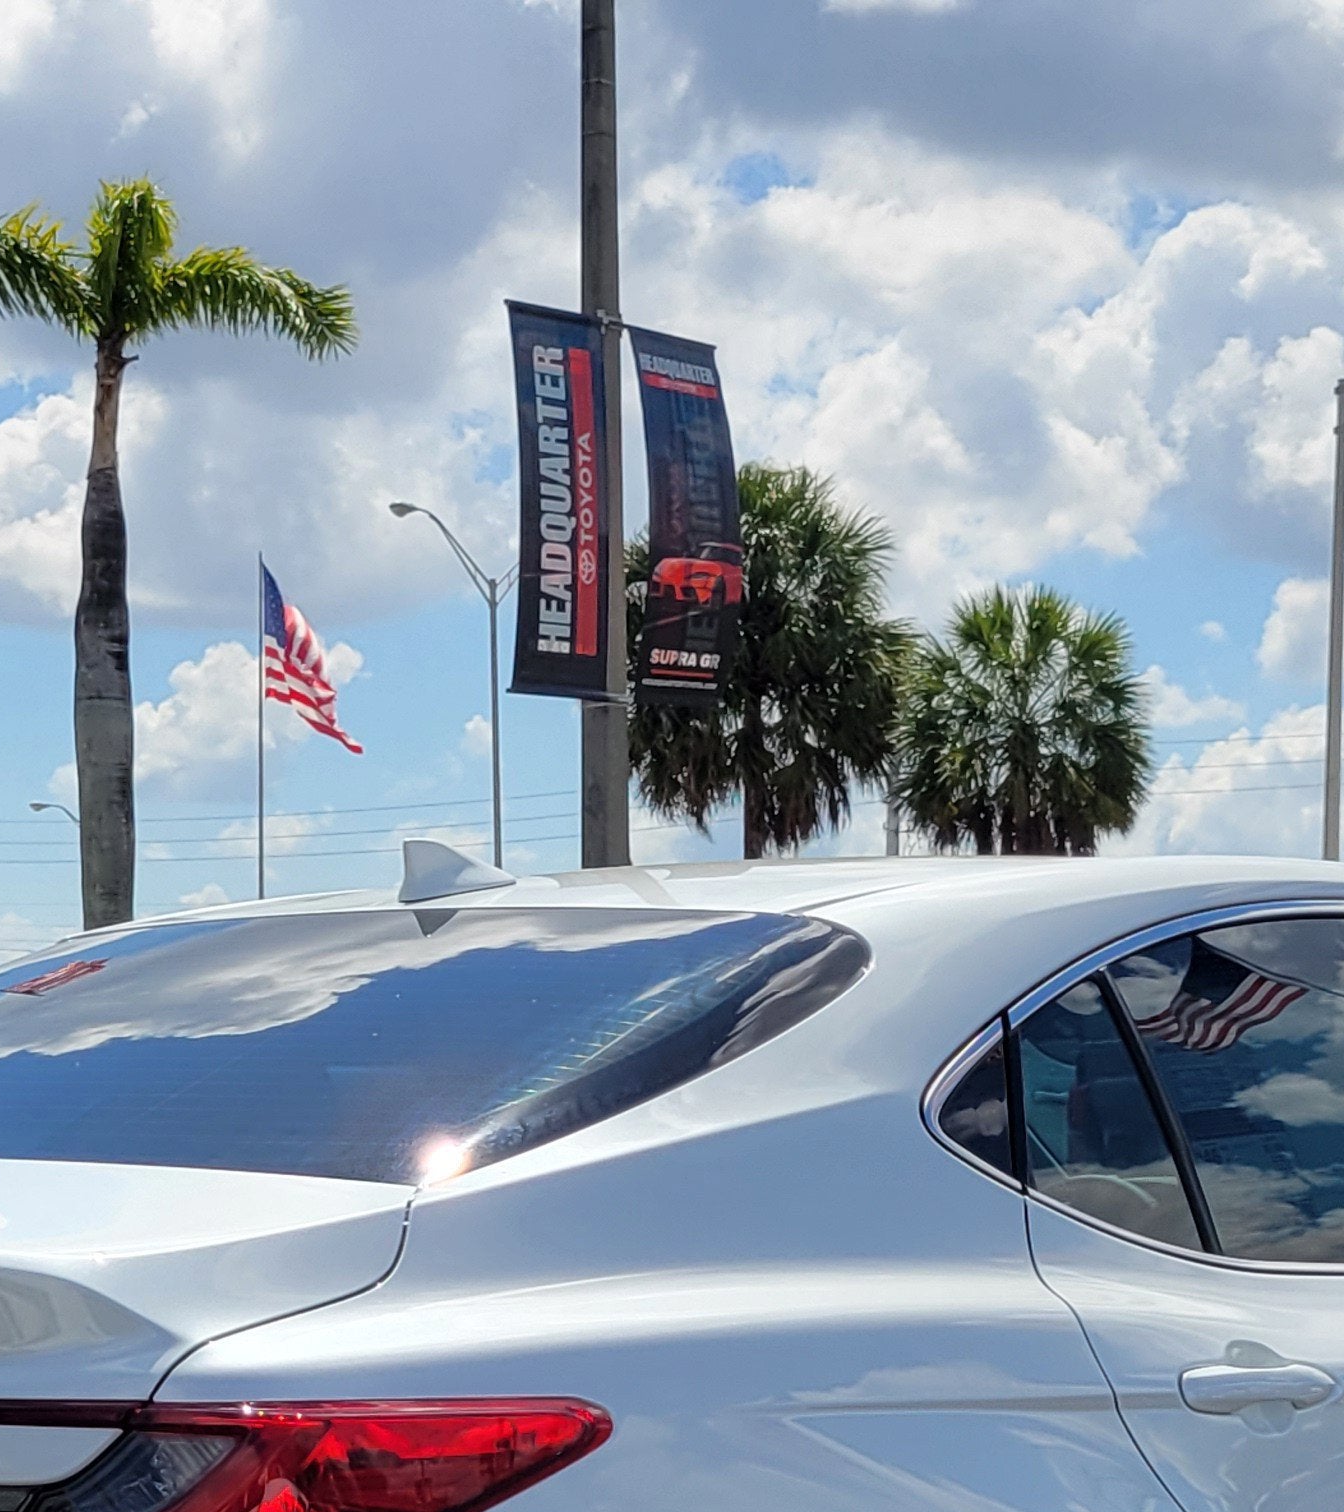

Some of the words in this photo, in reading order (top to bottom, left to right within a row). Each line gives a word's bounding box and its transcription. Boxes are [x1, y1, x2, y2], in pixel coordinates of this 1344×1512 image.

[639, 352, 716, 386] HEADQUARTER
[531, 344, 577, 655] HEADQUARTER
[577, 432, 595, 546] TOYOTA
[649, 648, 697, 667] SUPRA
[699, 653, 721, 669] GR
